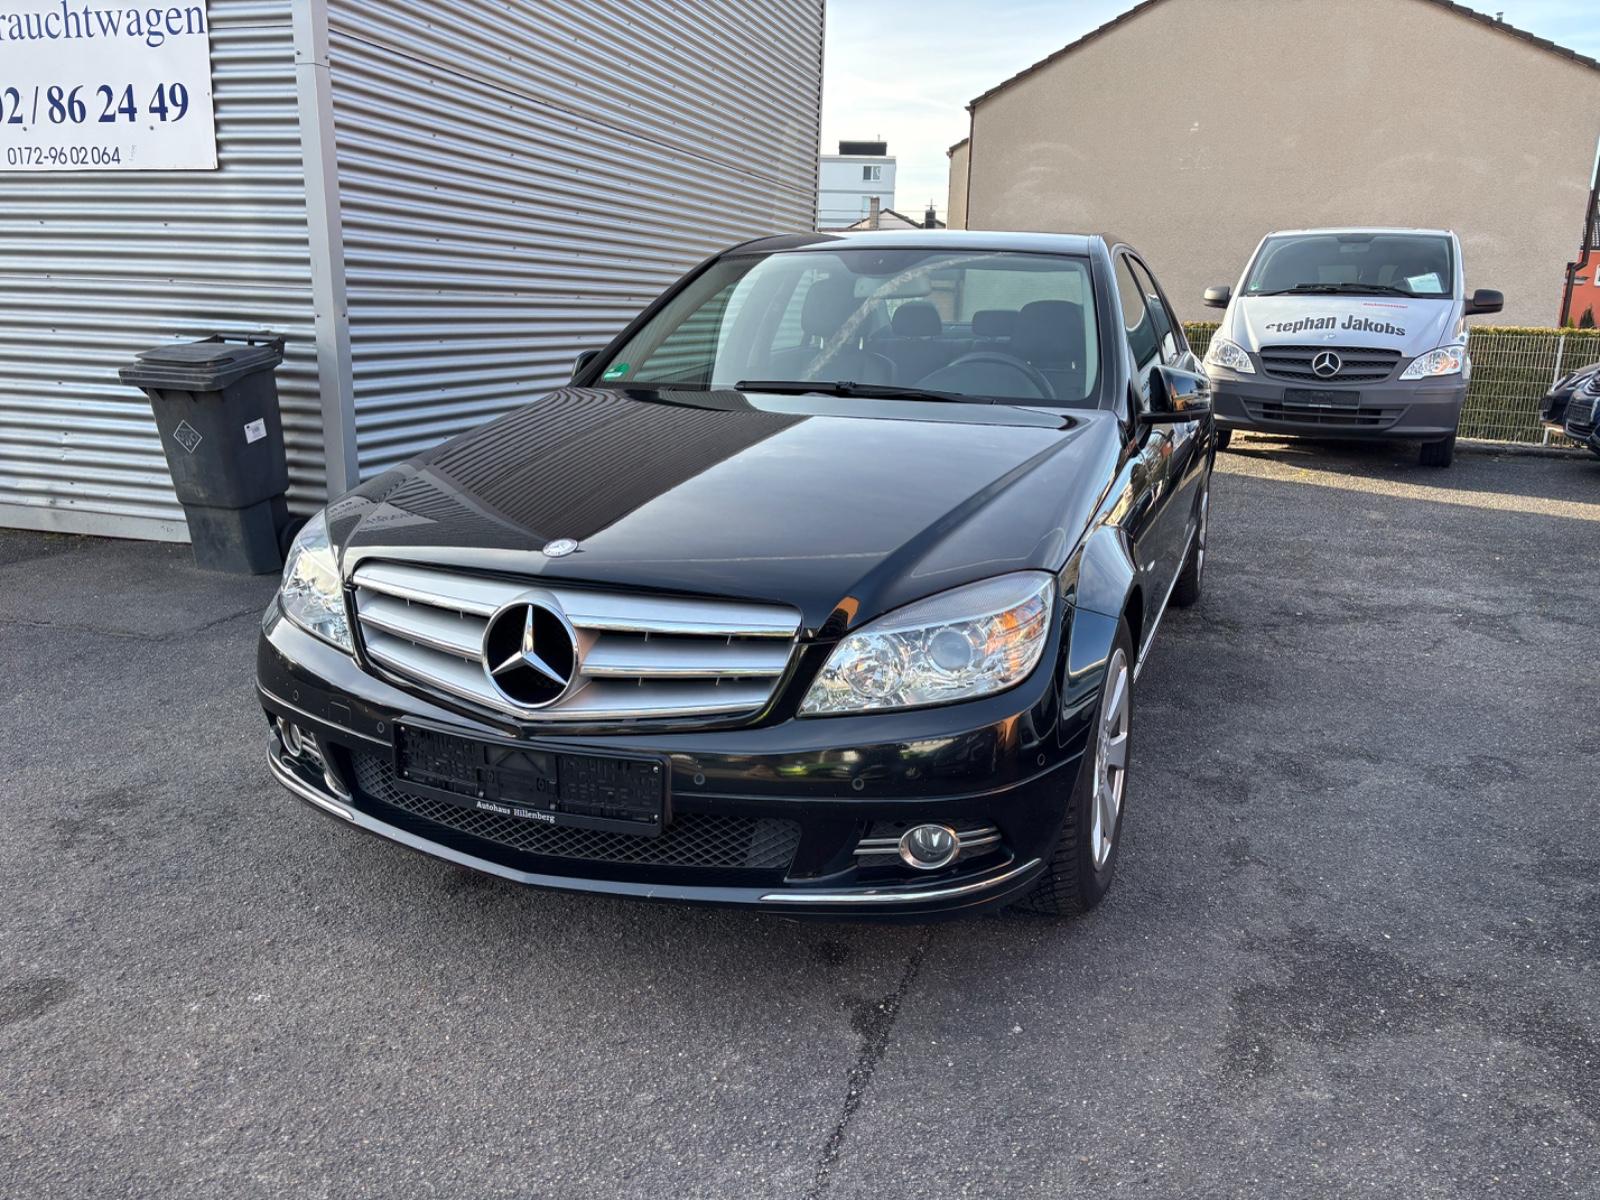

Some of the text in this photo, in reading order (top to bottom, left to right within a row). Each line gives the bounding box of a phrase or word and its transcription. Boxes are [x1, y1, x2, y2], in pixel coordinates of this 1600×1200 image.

[1341, 315, 1405, 336] Jakobs
[476, 801, 555, 824] Autohaus Hillenberg
